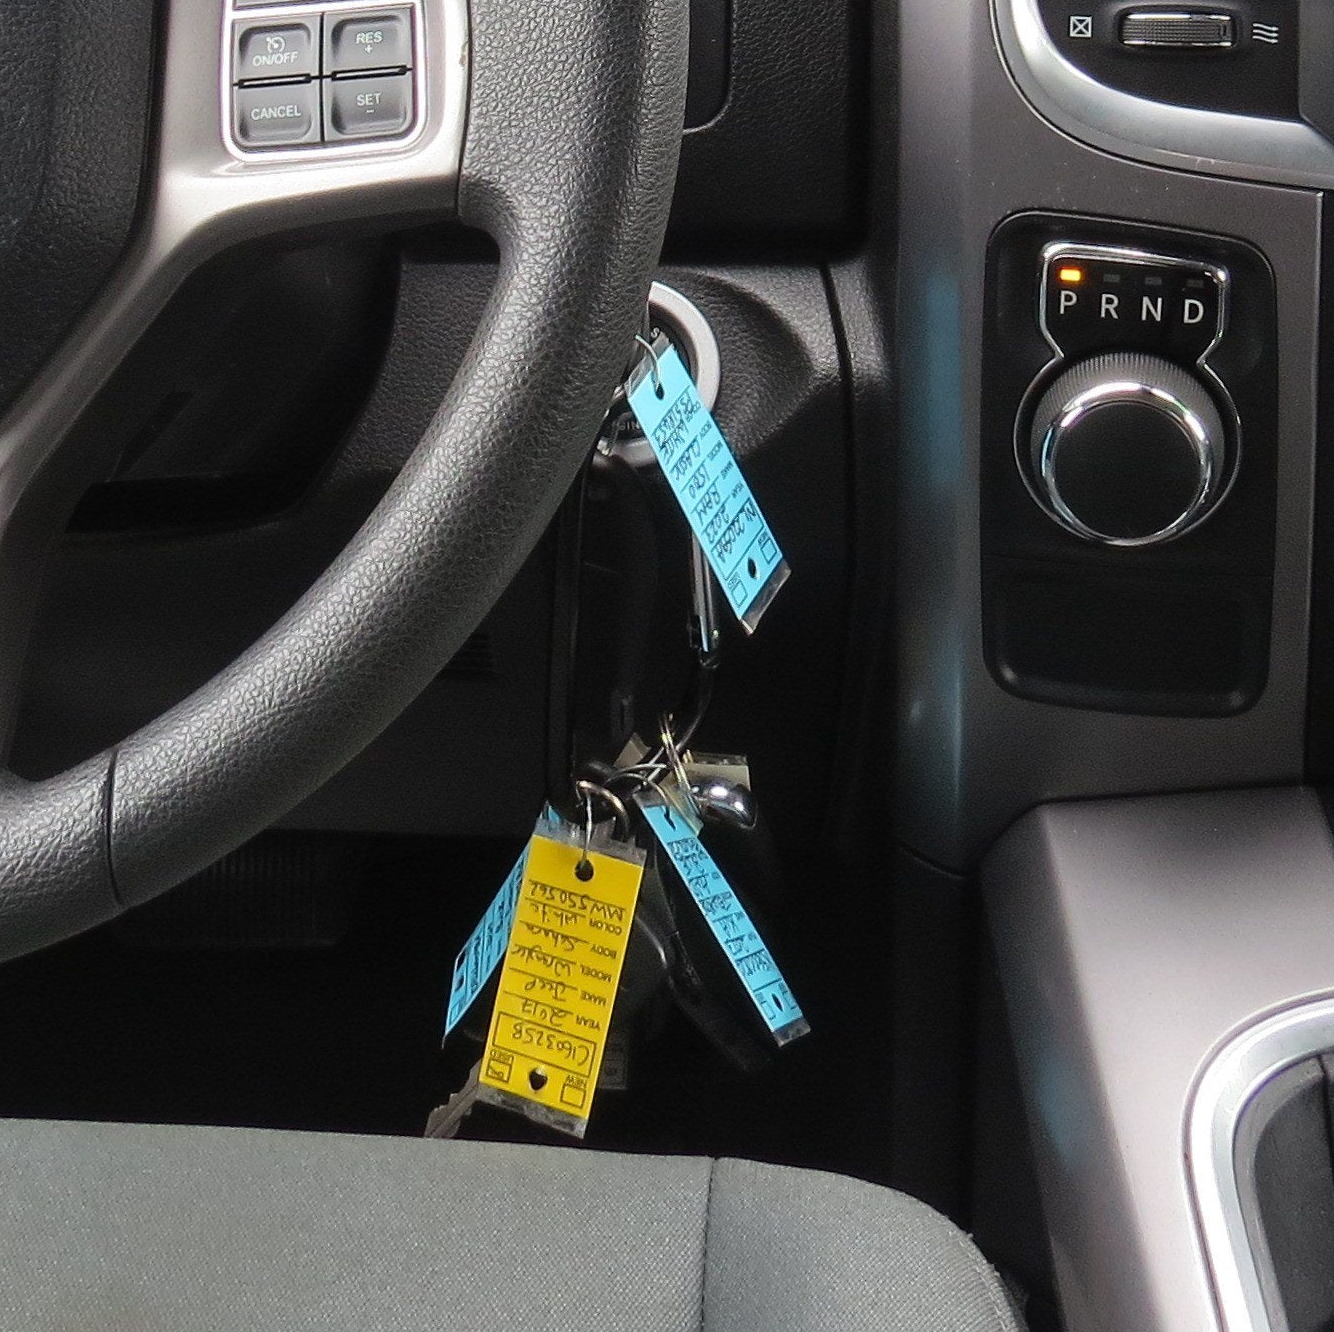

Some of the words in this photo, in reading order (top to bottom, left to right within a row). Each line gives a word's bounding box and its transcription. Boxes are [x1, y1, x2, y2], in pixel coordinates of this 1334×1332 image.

[356, 31, 382, 44] RES
[253, 53, 298, 66] ON/OFF
[357, 94, 381, 106] SET
[251, 105, 302, 120] CANCEL
[1060, 291, 1077, 314] P
[1101, 294, 1118, 318] R
[1141, 297, 1162, 321] N
[1184, 300, 1204, 323] D
[694, 482, 722, 526] RAM
[589, 919, 622, 936] COLOR
[590, 943, 617, 960] BODY
[580, 965, 612, 983] MODEL
[580, 990, 607, 1006] MAKE
[575, 1015, 601, 1031] YEAR
